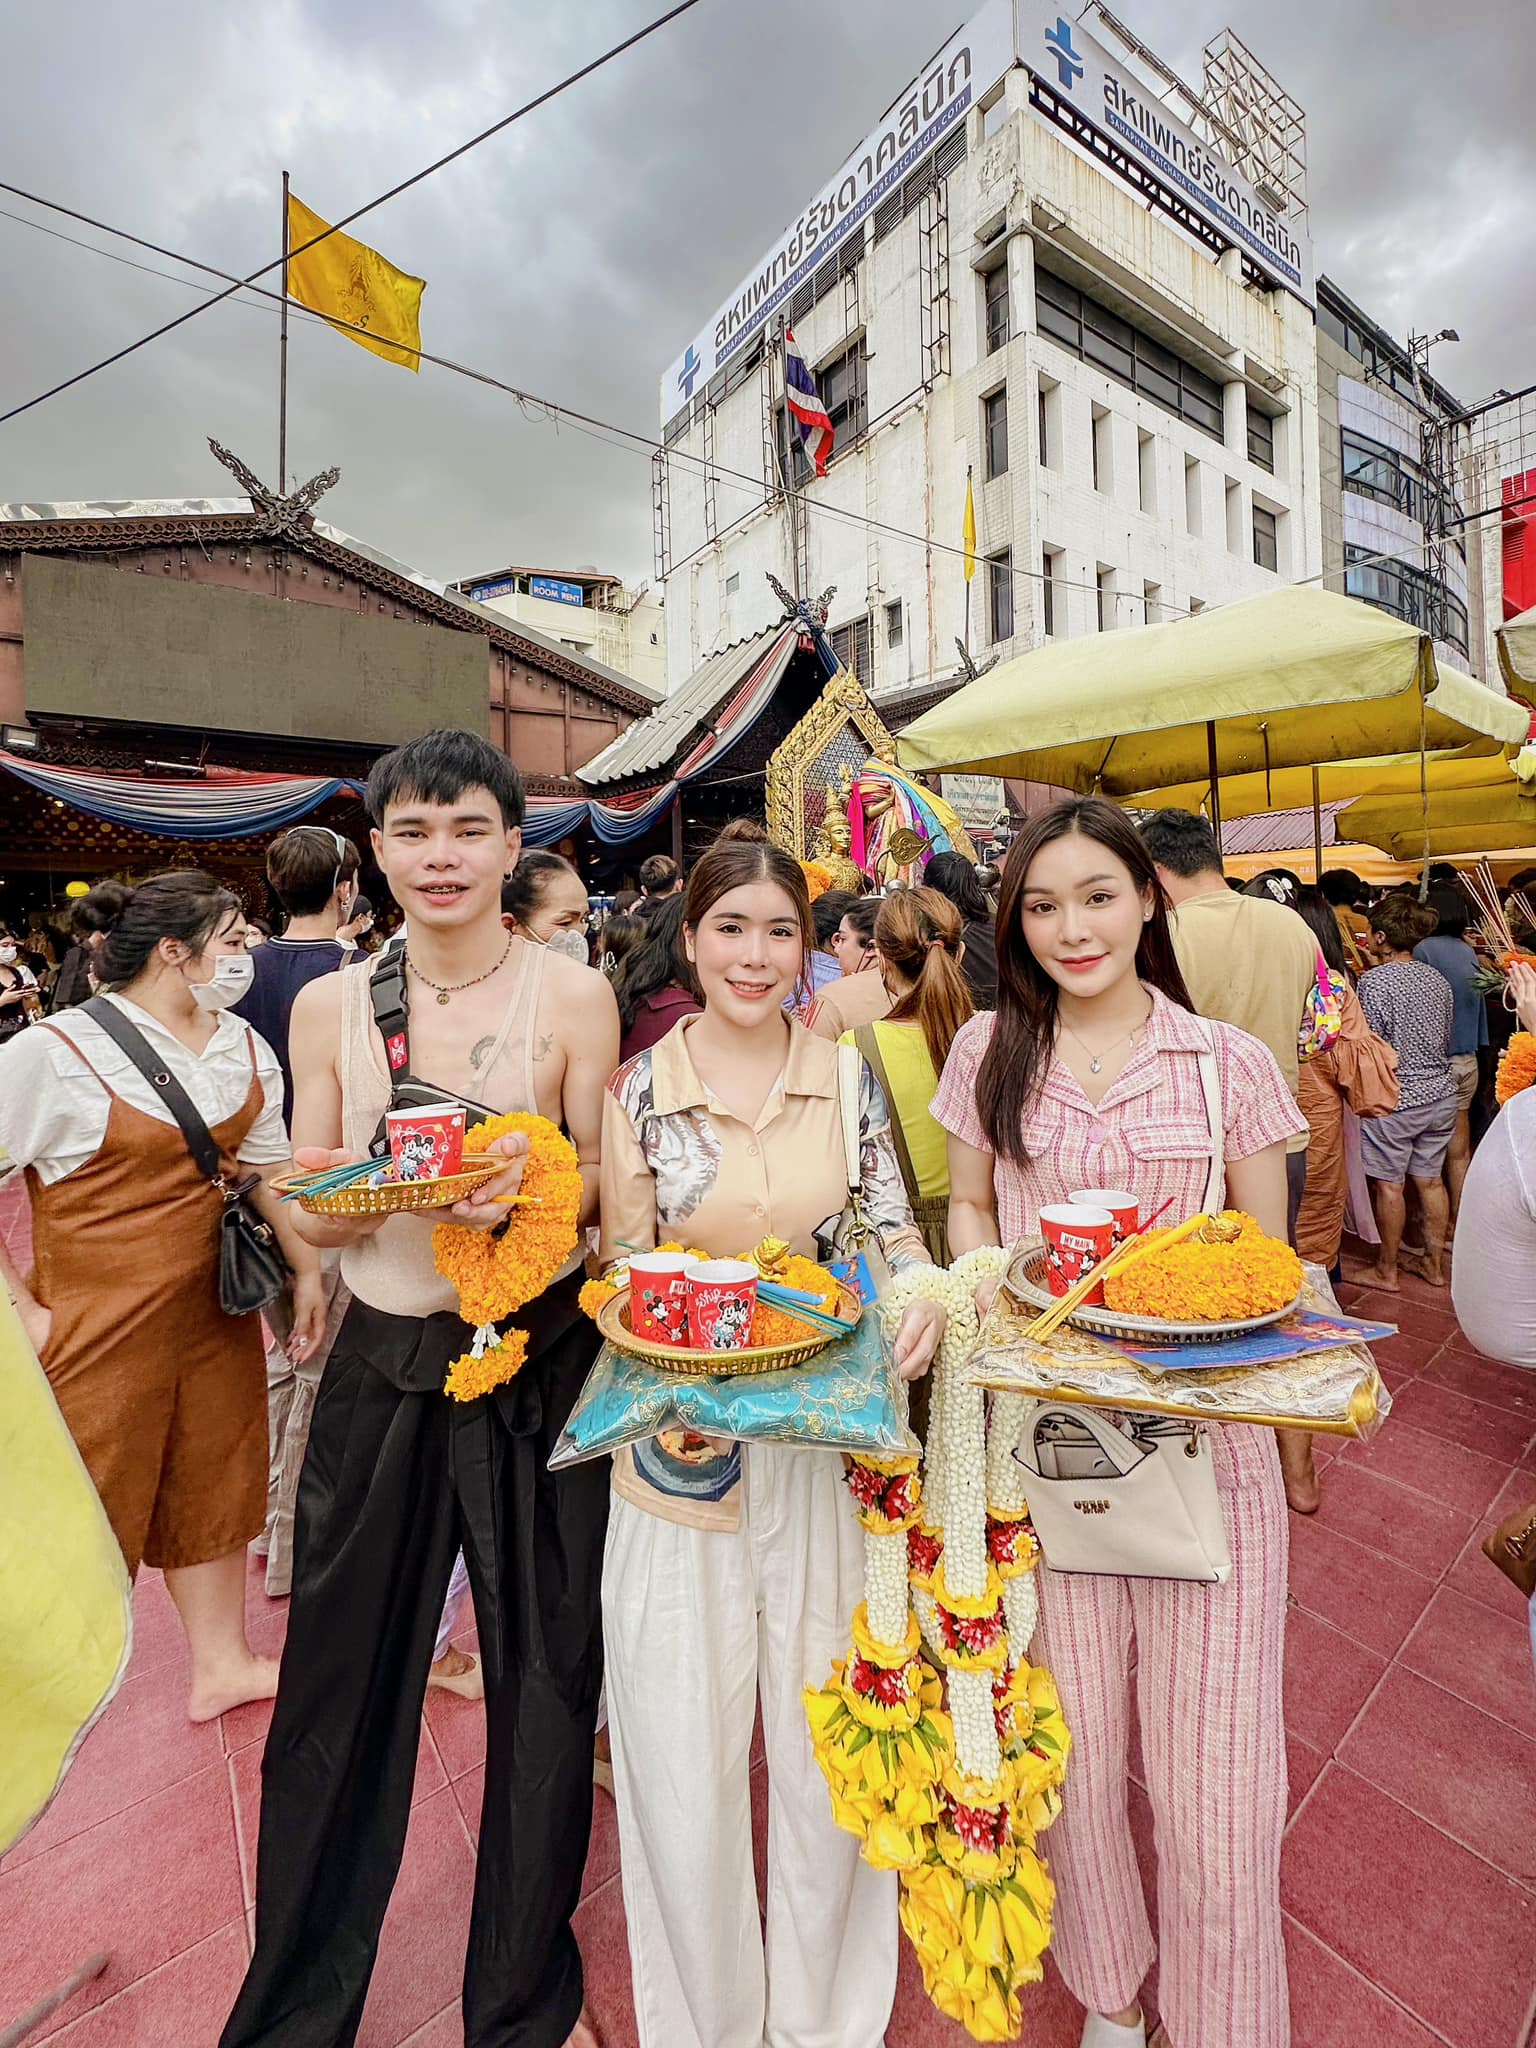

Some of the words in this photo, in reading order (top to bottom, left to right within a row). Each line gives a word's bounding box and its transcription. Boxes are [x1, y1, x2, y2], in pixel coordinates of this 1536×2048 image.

[715, 47, 972, 348] สหแพทย์รัชดาคลินิก
[719, 323, 751, 361] SAHAPHAT
[751, 287, 786, 325] RATCHADA
[787, 258, 812, 288] CLINIC
[821, 95, 966, 252] www.sahaphatratchada.com
[1104, 74, 1301, 269] สหแพทย์รัชดาคลินิก
[1109, 114, 1149, 154] SAHAPHAT
[1150, 149, 1186, 187] RATCHADA
[1187, 183, 1209, 206] CLINIC
[534, 585, 559, 599] ROOM
[561, 591, 580, 603] RENT
[1064, 1235, 1074, 1245] MY
[1075, 1239, 1090, 1250] MAIN
